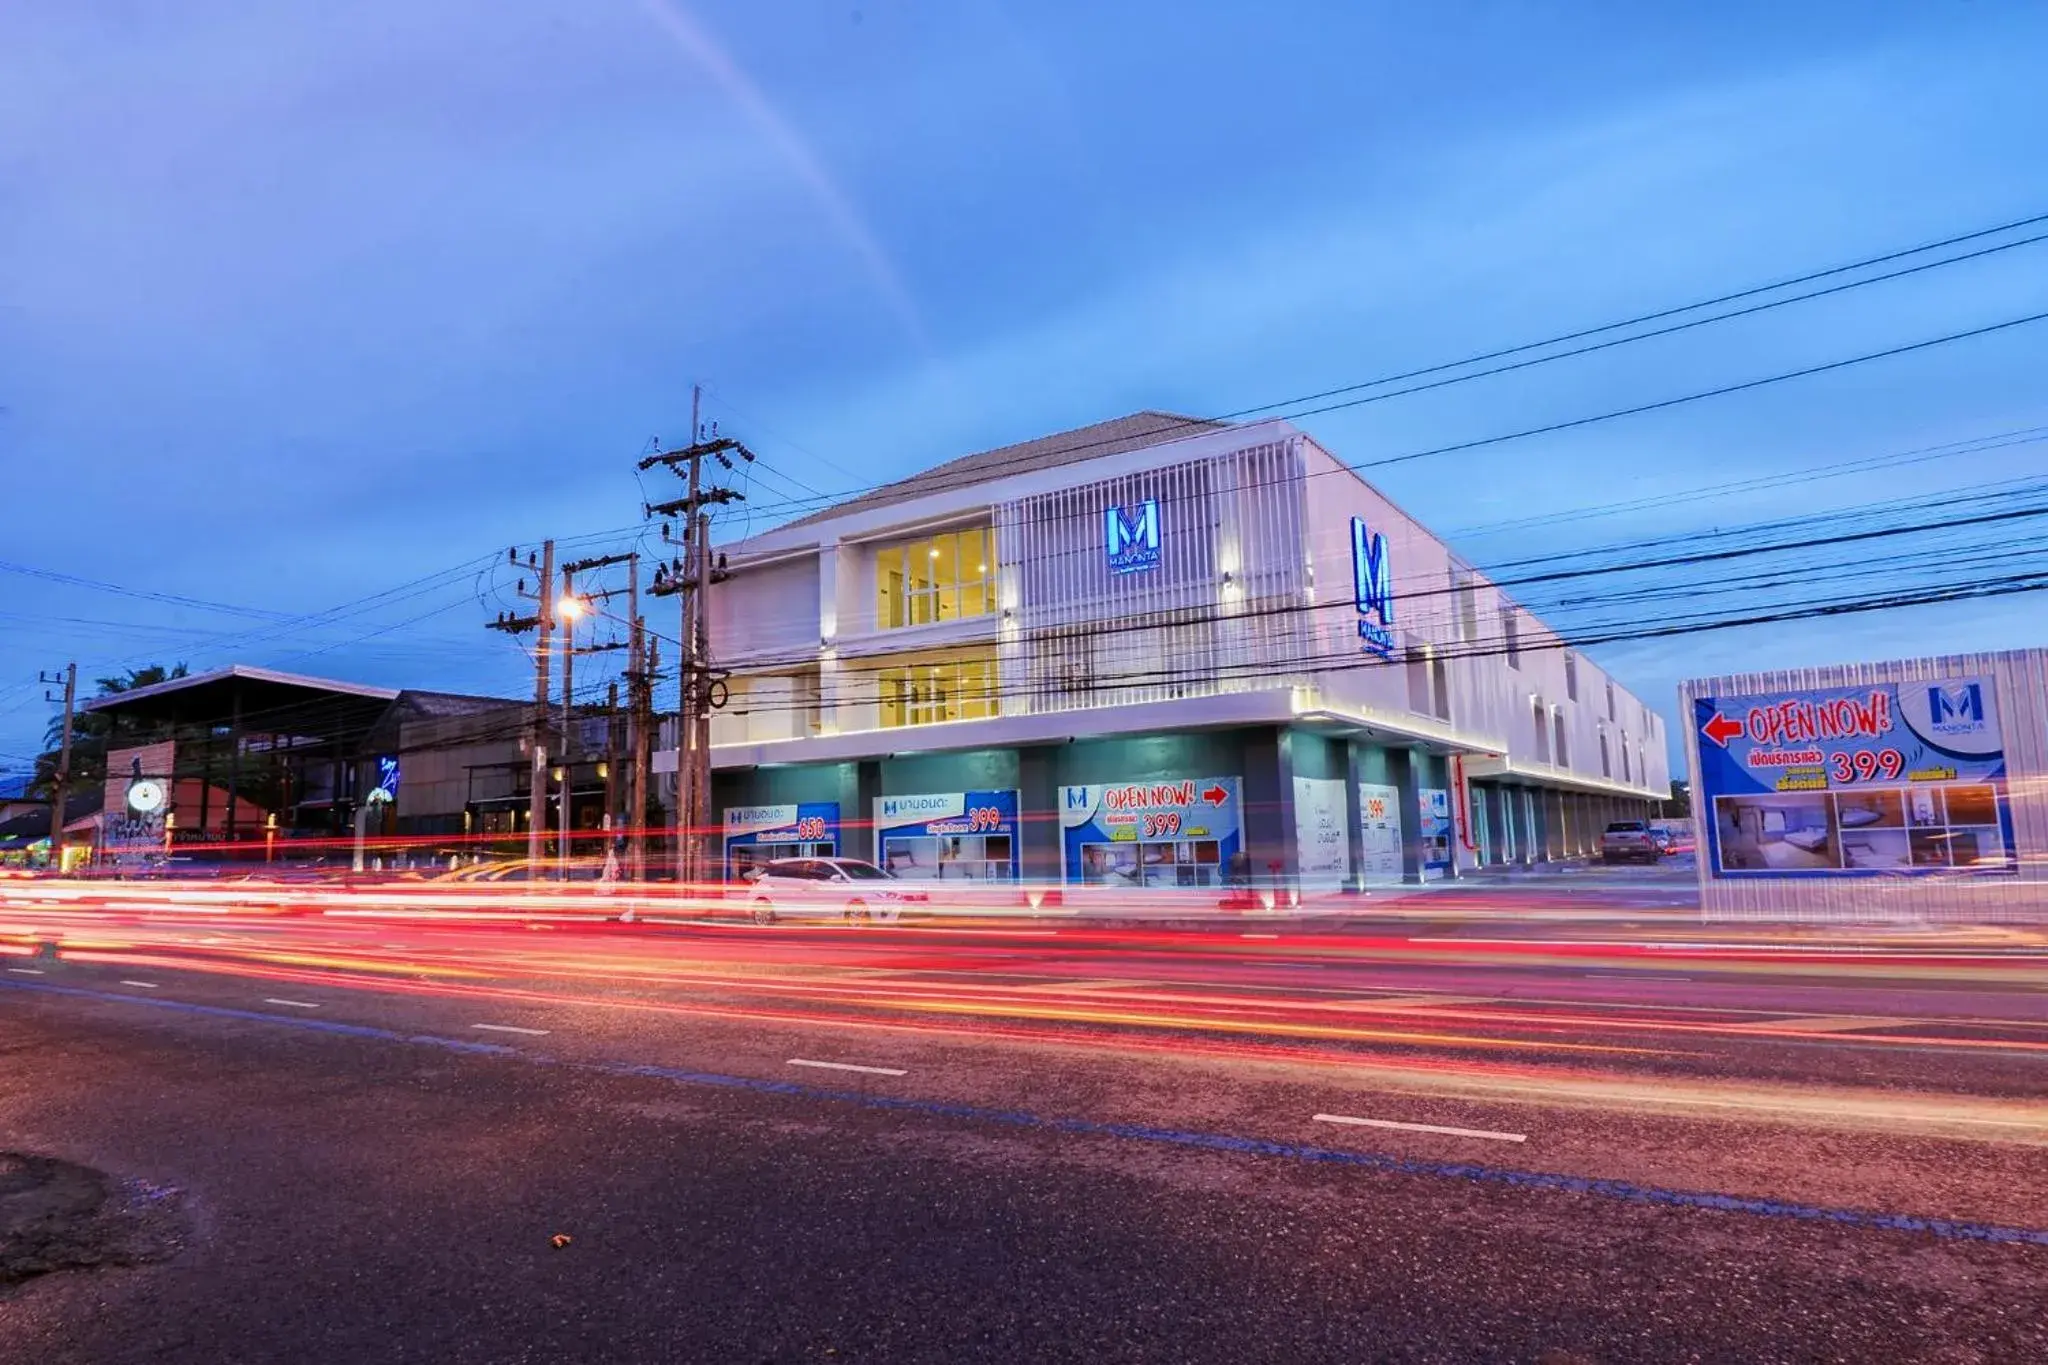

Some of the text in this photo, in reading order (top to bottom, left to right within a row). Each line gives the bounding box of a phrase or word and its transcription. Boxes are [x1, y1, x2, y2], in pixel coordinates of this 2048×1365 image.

[1107, 500, 1159, 556] M
[1928, 684, 1983, 724] M
[1749, 693, 1888, 744] OPEN NOW!
[1831, 749, 1903, 782] 399
[1067, 787, 1088, 809] M
[1106, 782, 1194, 809] OPEN NOW!
[799, 817, 824, 839] 650
[971, 808, 999, 831] 399
[1143, 814, 1180, 836] 399
